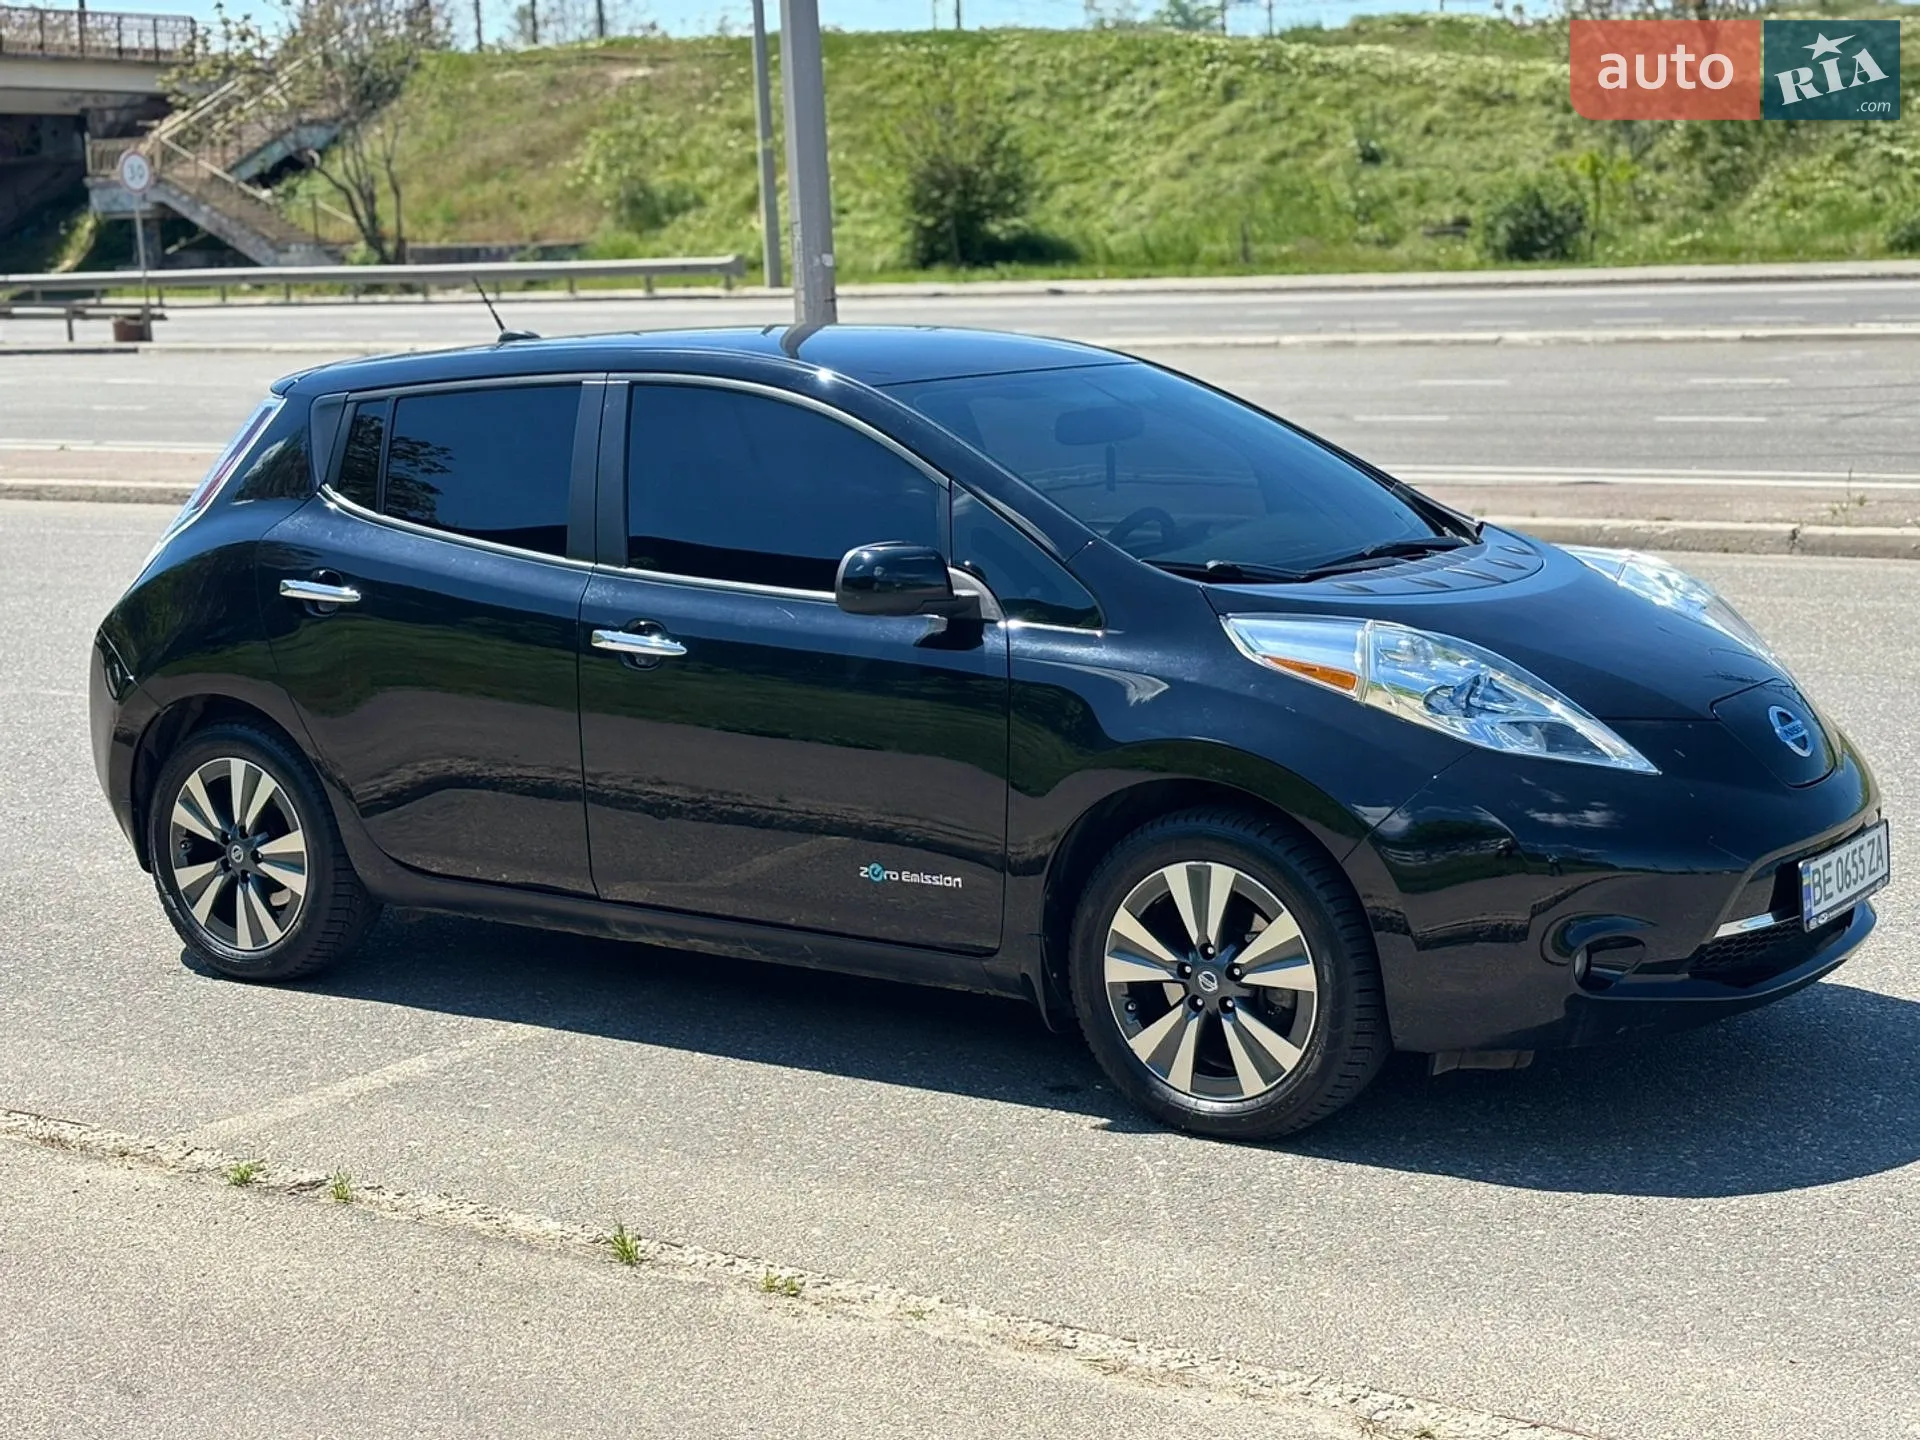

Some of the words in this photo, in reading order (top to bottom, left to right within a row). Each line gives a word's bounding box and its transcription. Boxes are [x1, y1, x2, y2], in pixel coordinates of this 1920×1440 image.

[1811, 861, 1834, 907] BE
[1835, 844, 1866, 894] 0655
[1867, 834, 1884, 877] ZA
